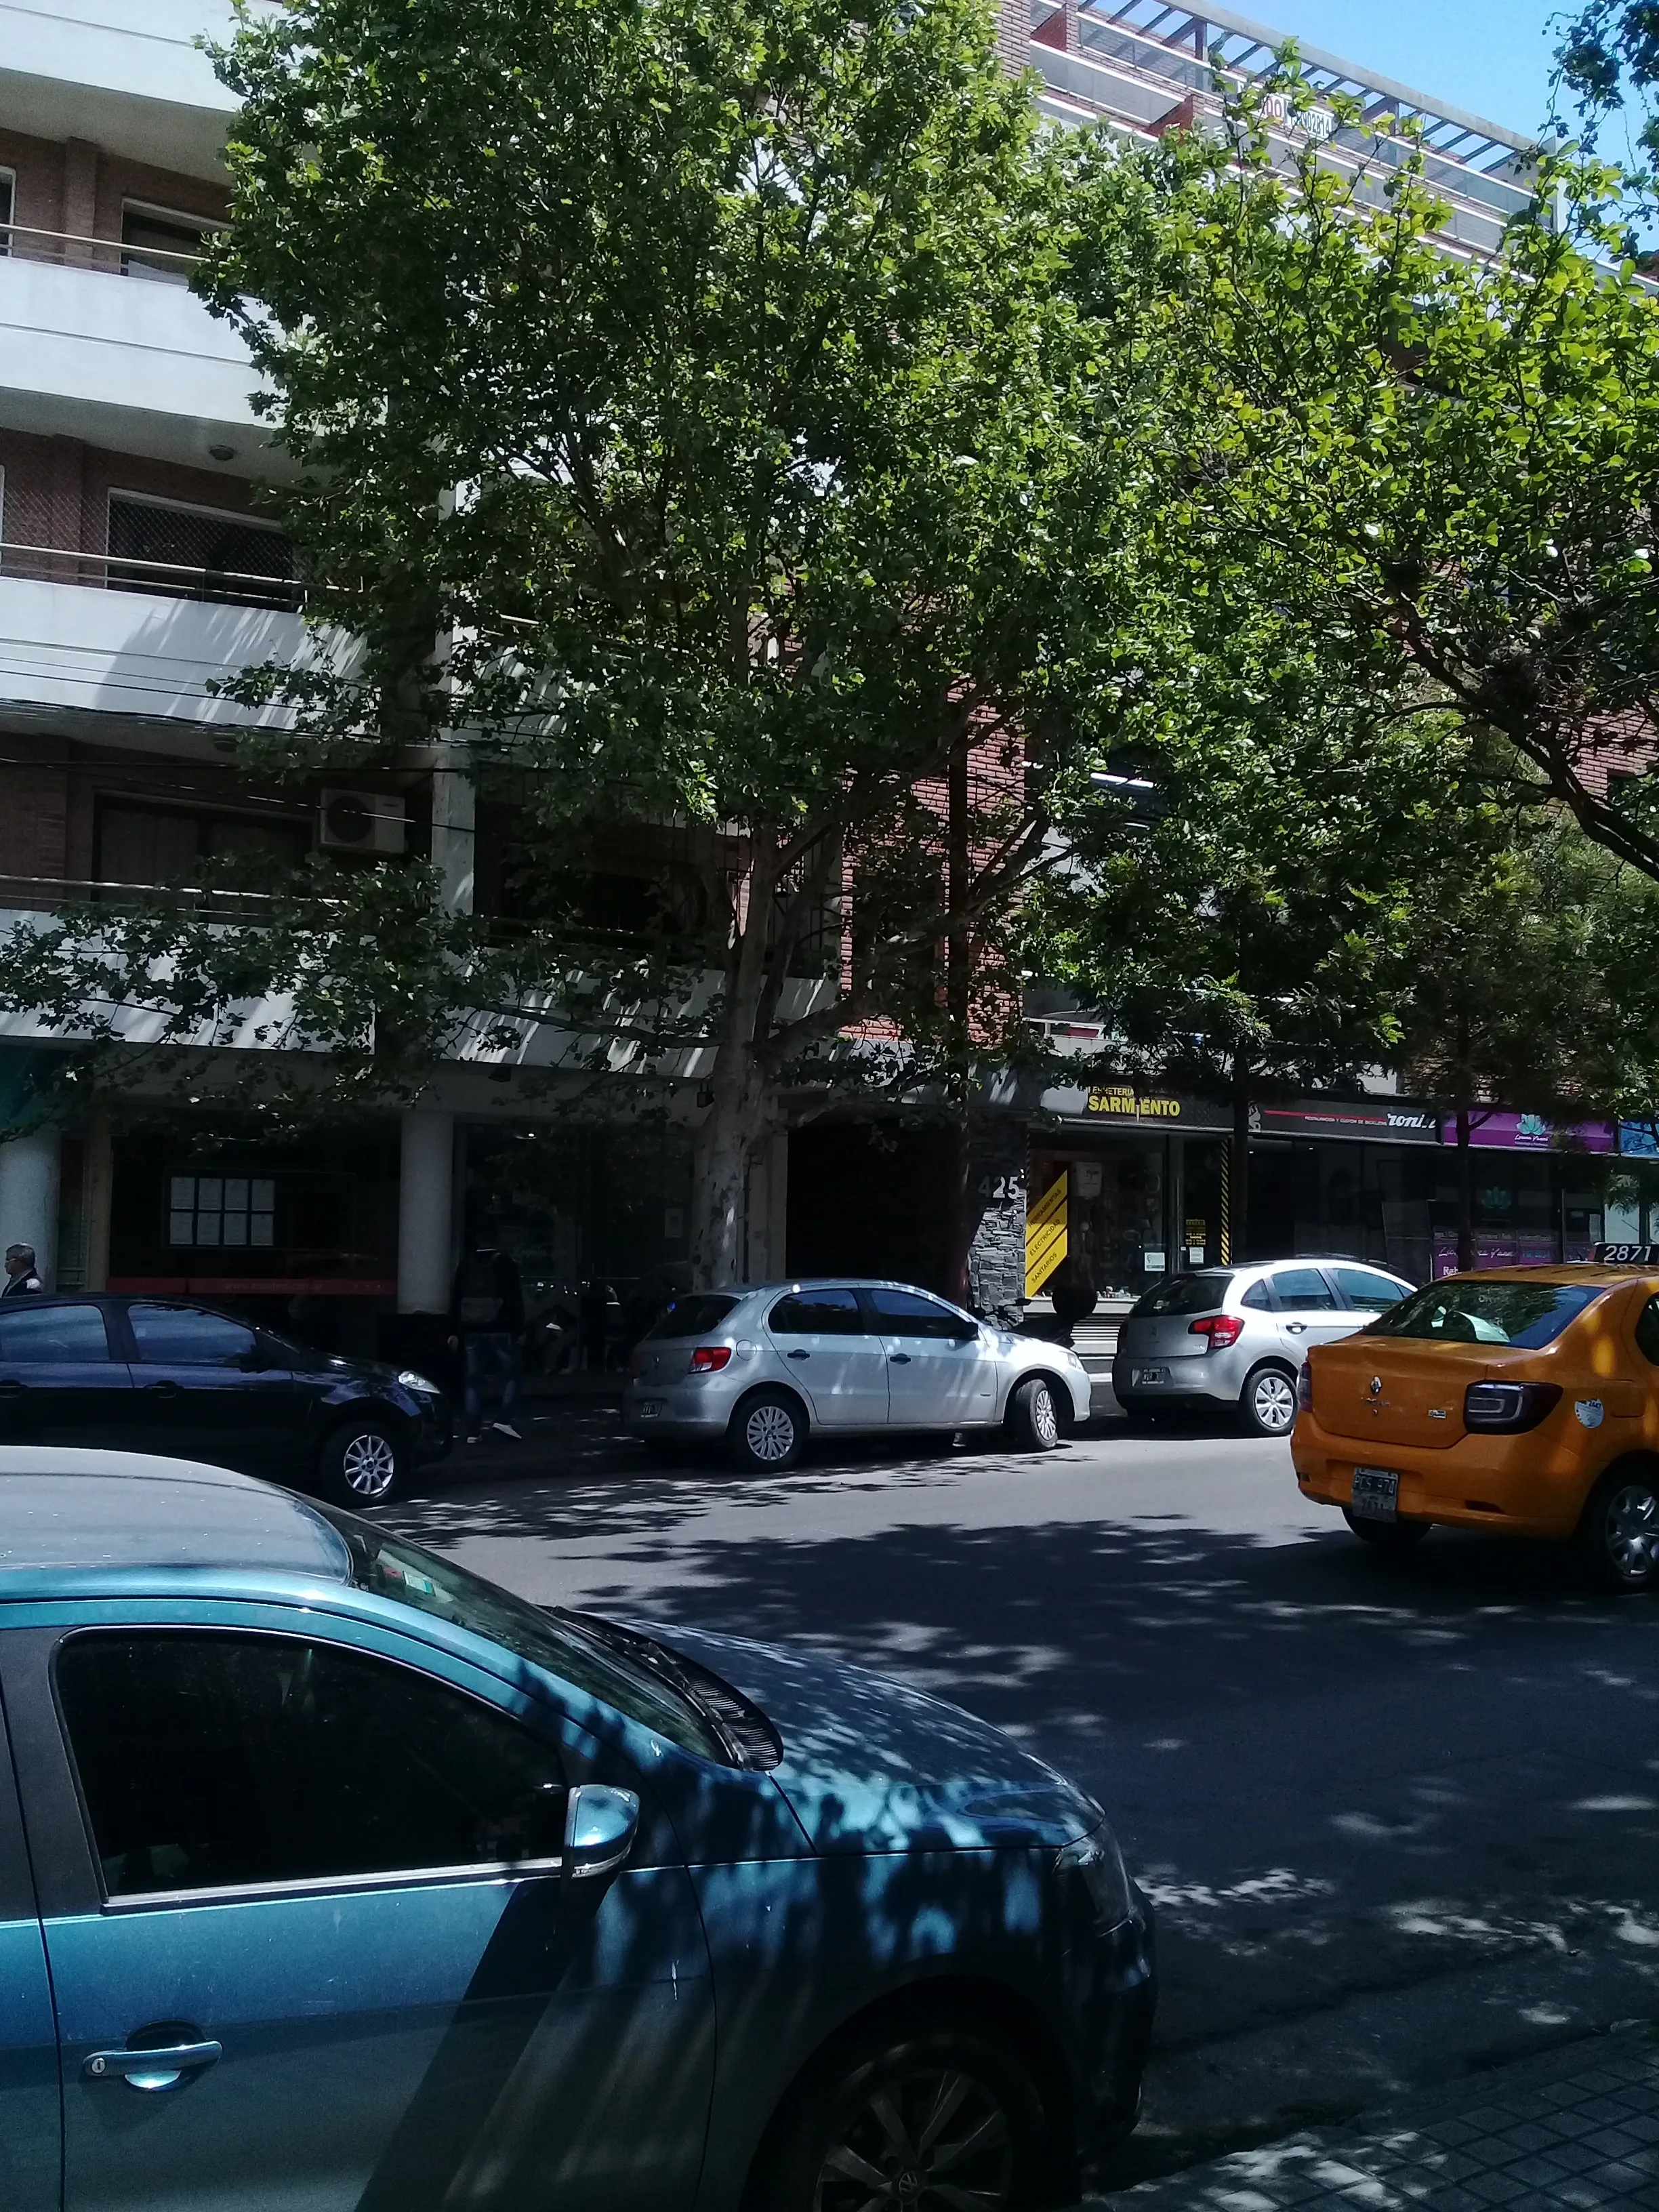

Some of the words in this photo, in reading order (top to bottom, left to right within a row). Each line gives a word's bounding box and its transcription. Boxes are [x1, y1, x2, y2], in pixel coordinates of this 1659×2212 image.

[1088, 1095, 1181, 1121] SARMIENTO
[978, 1175, 1020, 1200] 425
[1029, 1218, 1061, 1257] ELECTRICIDAD
[1603, 1245, 1652, 1262] 2871
[1030, 1251, 1059, 1284] SANITARIOS
